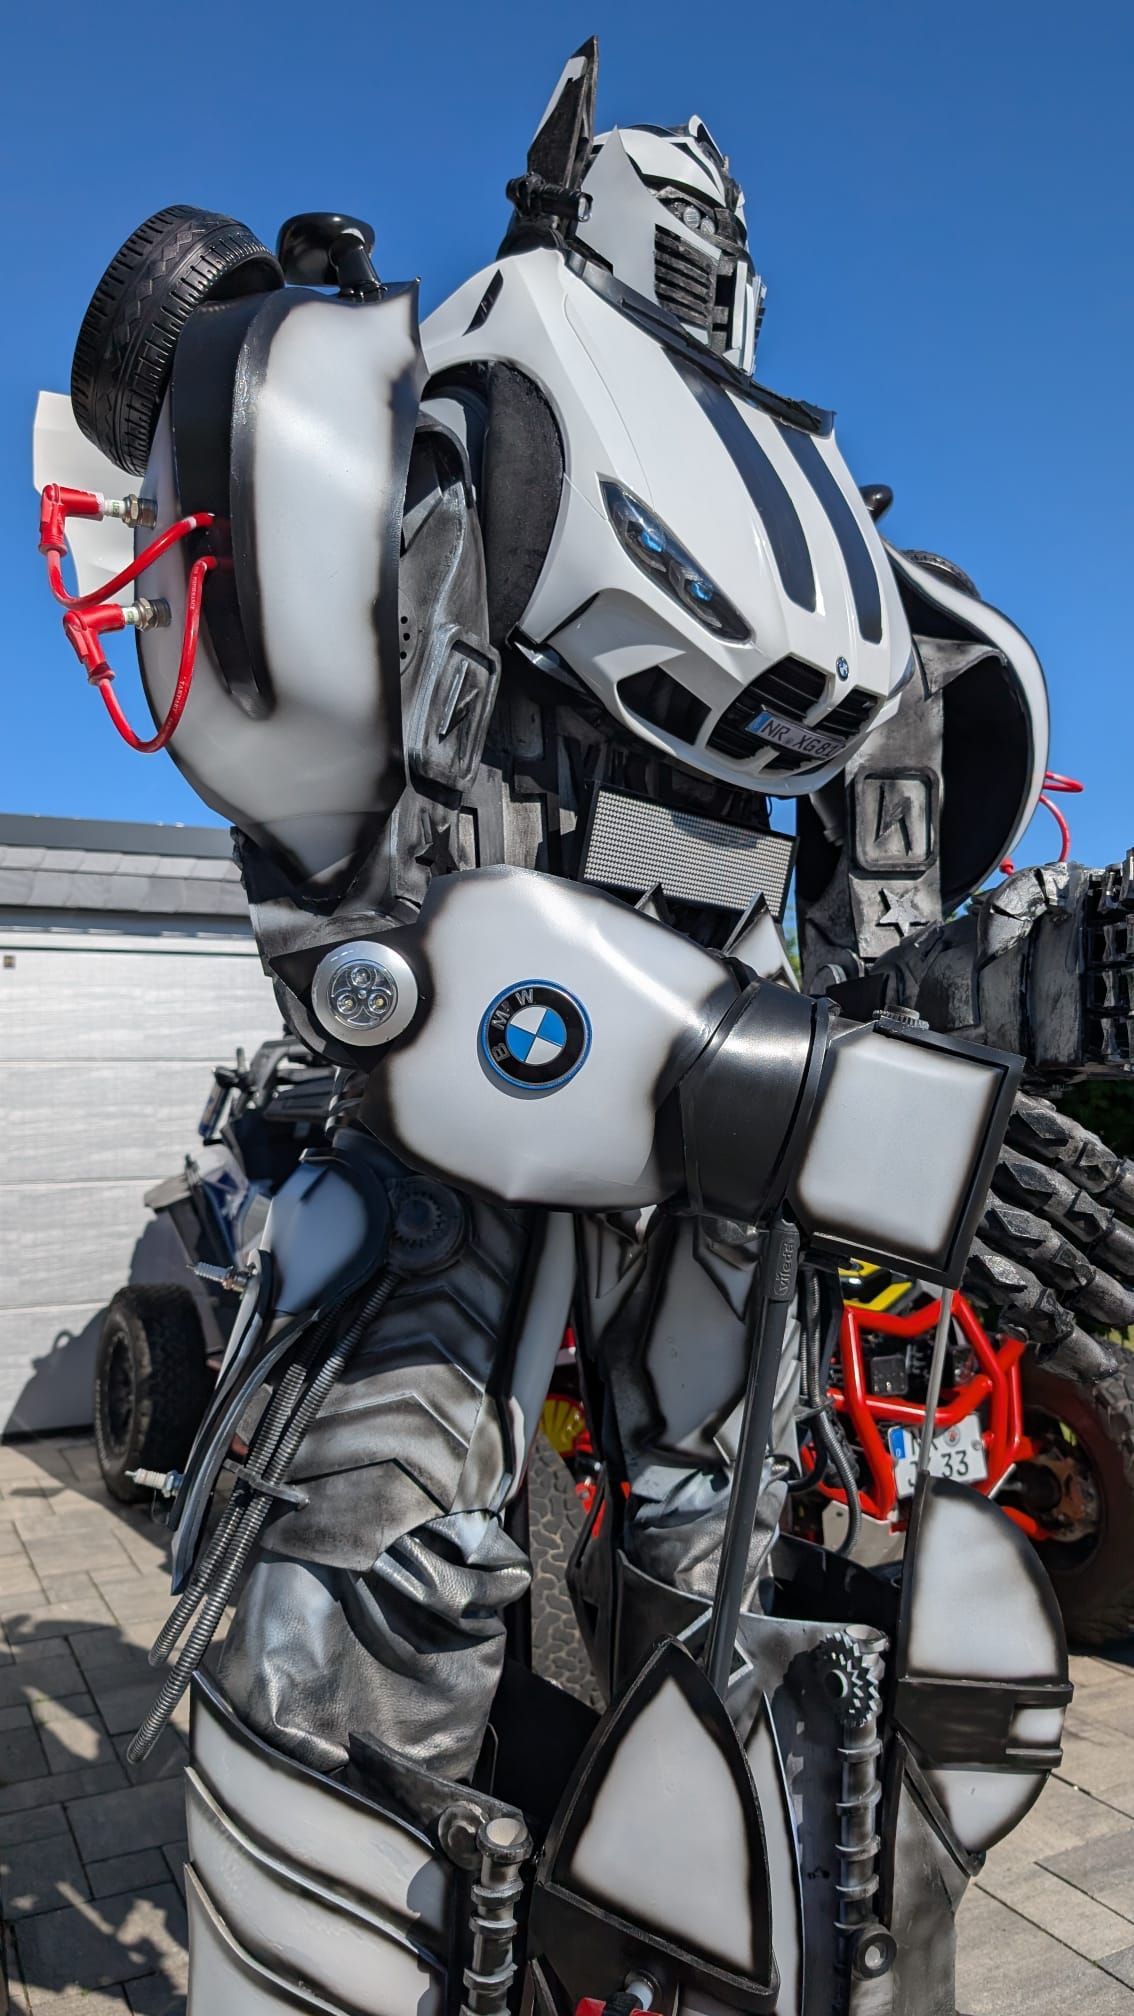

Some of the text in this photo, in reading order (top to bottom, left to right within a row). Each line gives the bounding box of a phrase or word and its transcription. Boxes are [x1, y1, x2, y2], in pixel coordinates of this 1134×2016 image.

[761, 719, 837, 757] NR XG81
[491, 988, 534, 1062] BMW
[941, 1450, 969, 1478] 33
